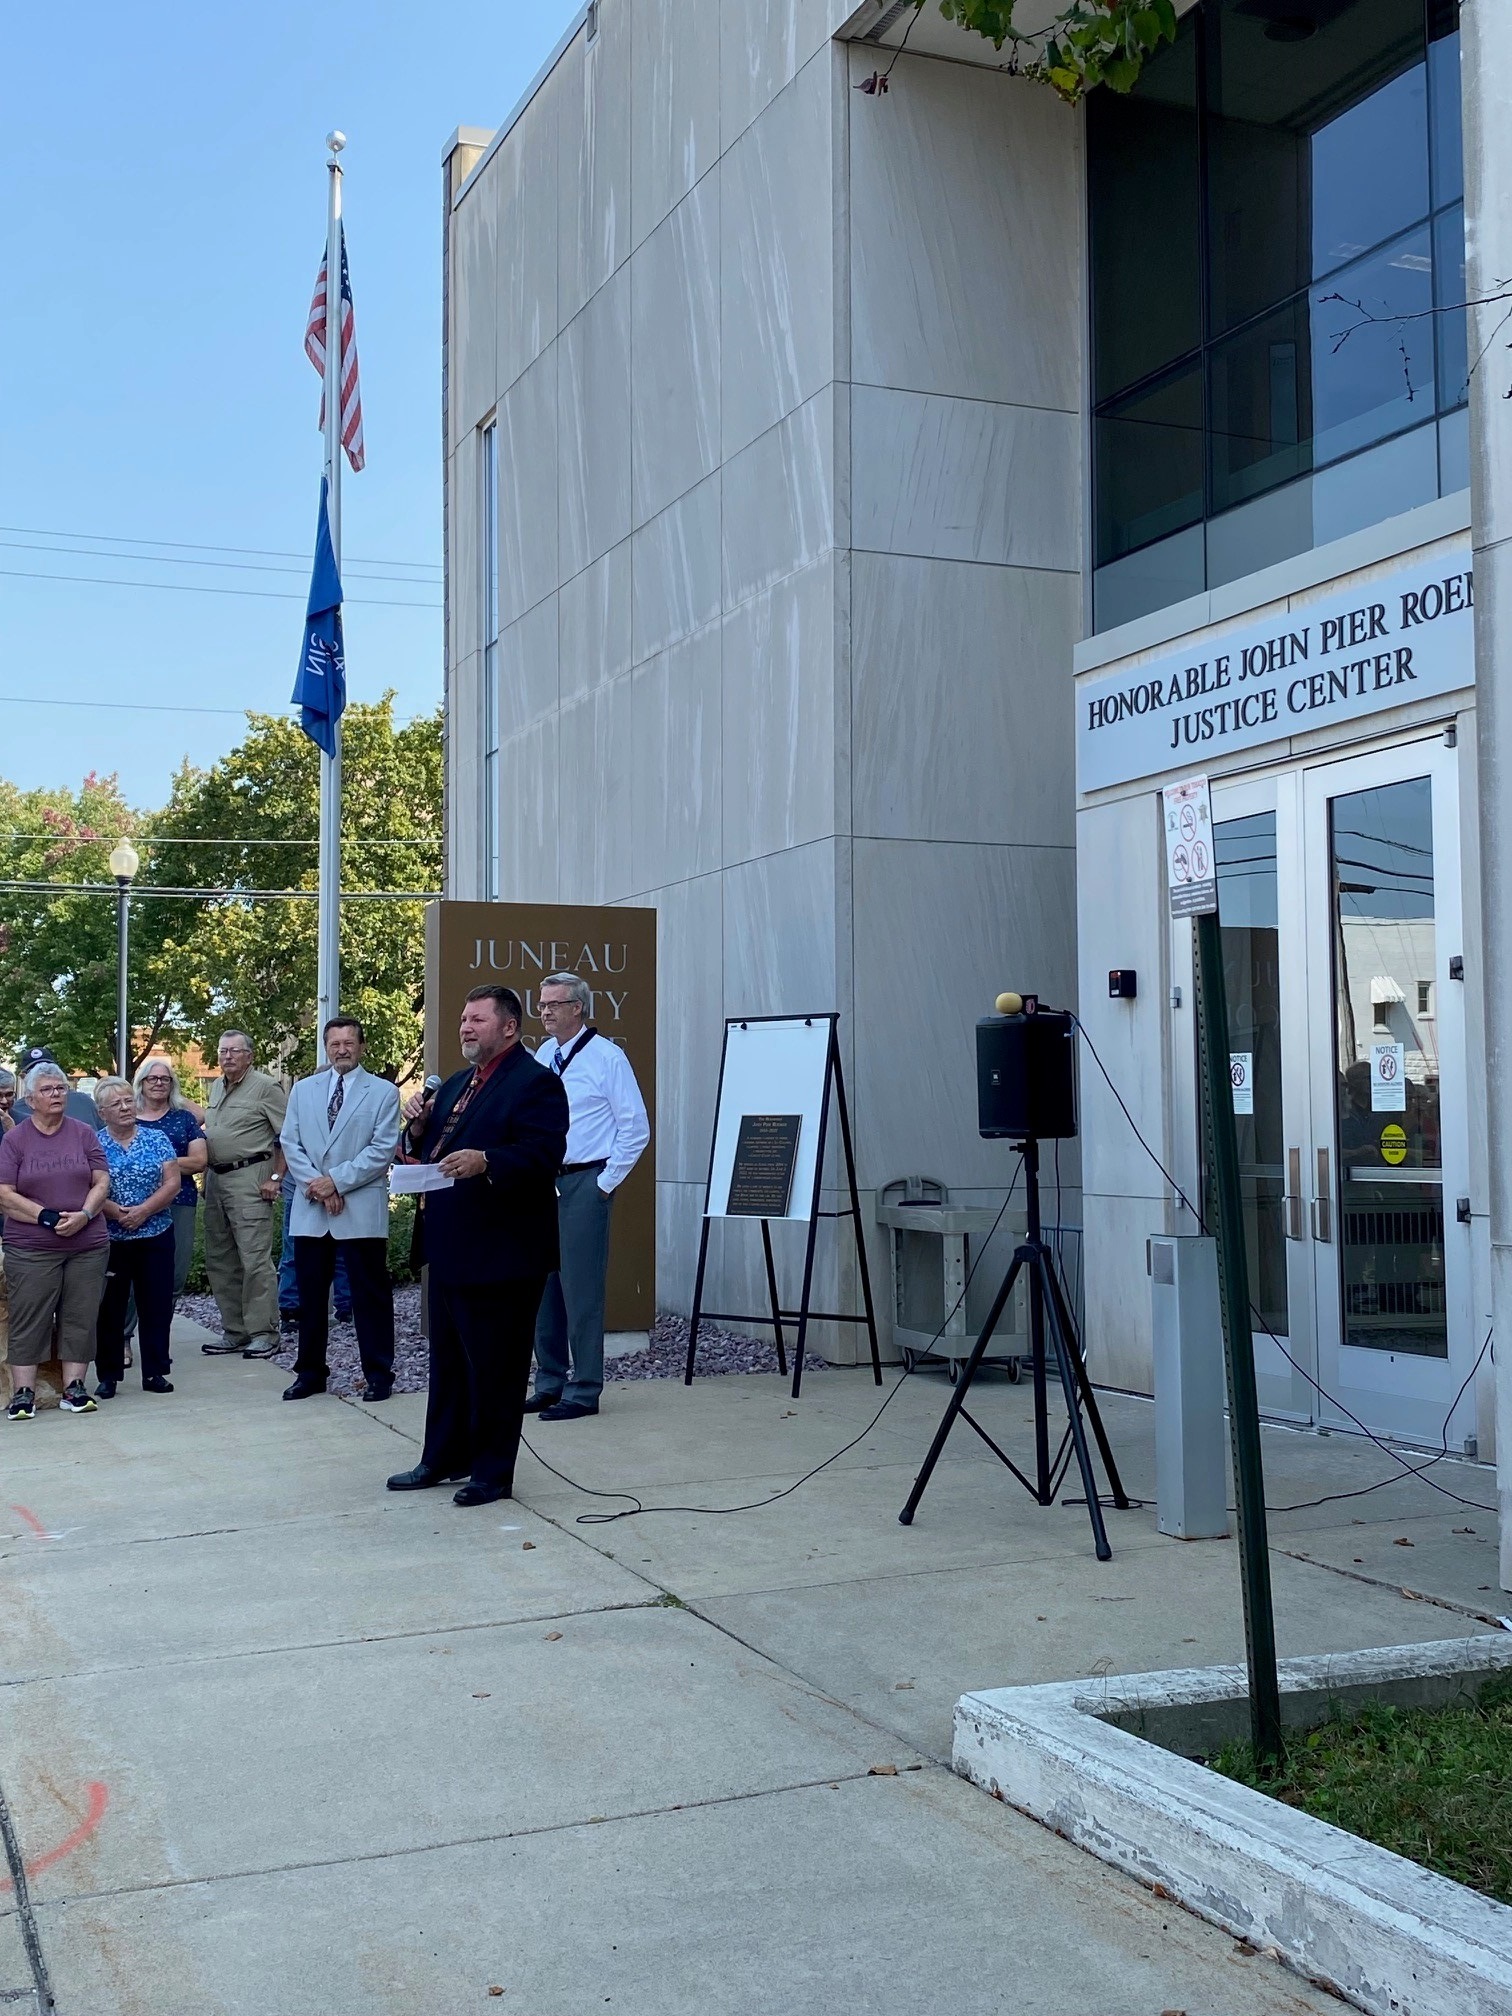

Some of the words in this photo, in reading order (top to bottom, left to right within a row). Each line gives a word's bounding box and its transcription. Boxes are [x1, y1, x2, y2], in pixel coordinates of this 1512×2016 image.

[1088, 656, 1232, 730] HONORABLE
[1238, 628, 1311, 681] JOHN
[1320, 603, 1390, 655] PIER
[1170, 688, 1278, 749] JUSTICE
[1286, 647, 1418, 713] CENTER
[469, 939, 628, 973] JUNEAU
[1375, 1045, 1398, 1055] NOTICE
